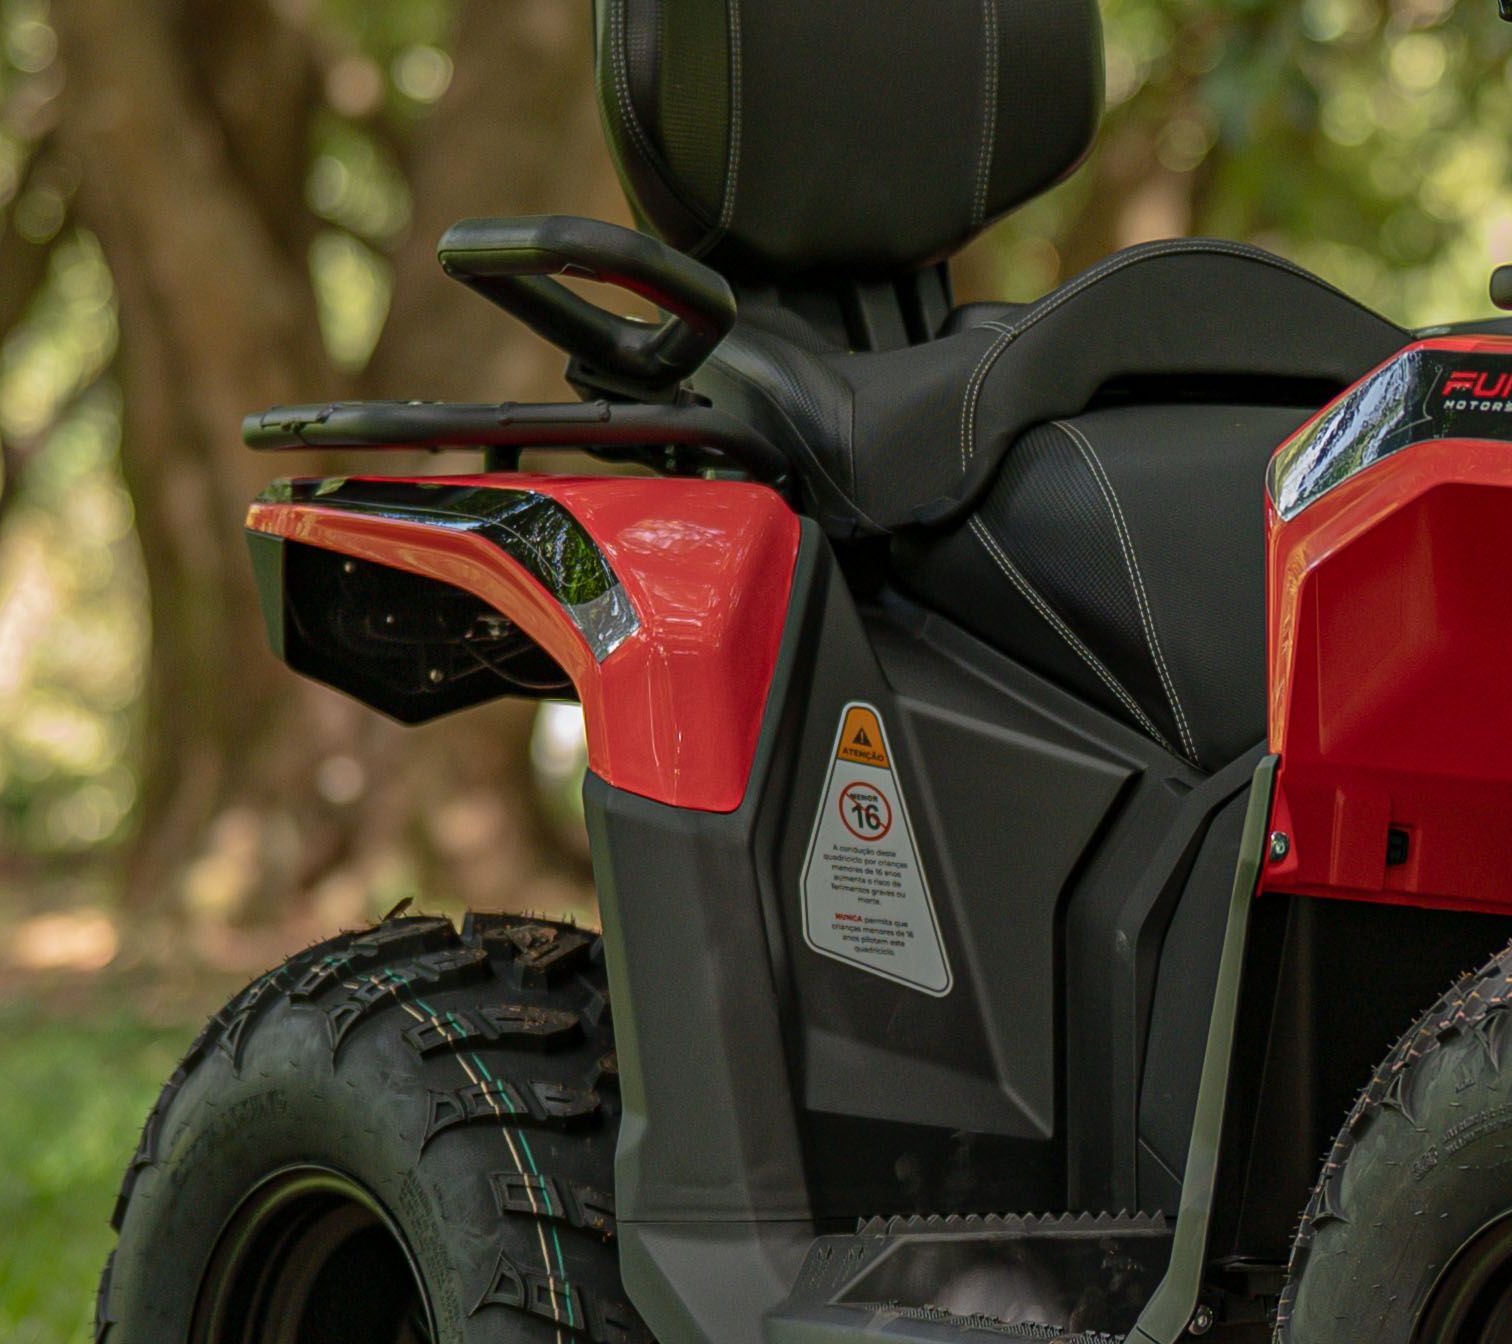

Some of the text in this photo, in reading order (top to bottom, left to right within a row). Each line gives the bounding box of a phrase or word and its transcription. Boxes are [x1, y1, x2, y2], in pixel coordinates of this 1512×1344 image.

[843, 748, 884, 761] ATENÇÃO
[849, 793, 878, 802] MENOR
[852, 804, 881, 830] 16
[839, 846, 875, 855] condução
[823, 853, 908, 869] quadriciclo por crianças
[831, 864, 864, 874] menores
[875, 868, 883, 876] 16
[833, 874, 866, 884] aumenta
[874, 879, 891, 887] risco
[892, 880, 902, 888] de
[831, 882, 870, 894] ferimentos
[871, 888, 895, 897] graves
[834, 912, 863, 922] NUNCA
[864, 917, 892, 926] permita
[831, 923, 914, 939] crianças menores de 16
[842, 934, 860, 942] anos
[861, 936, 889, 945] pilotem
